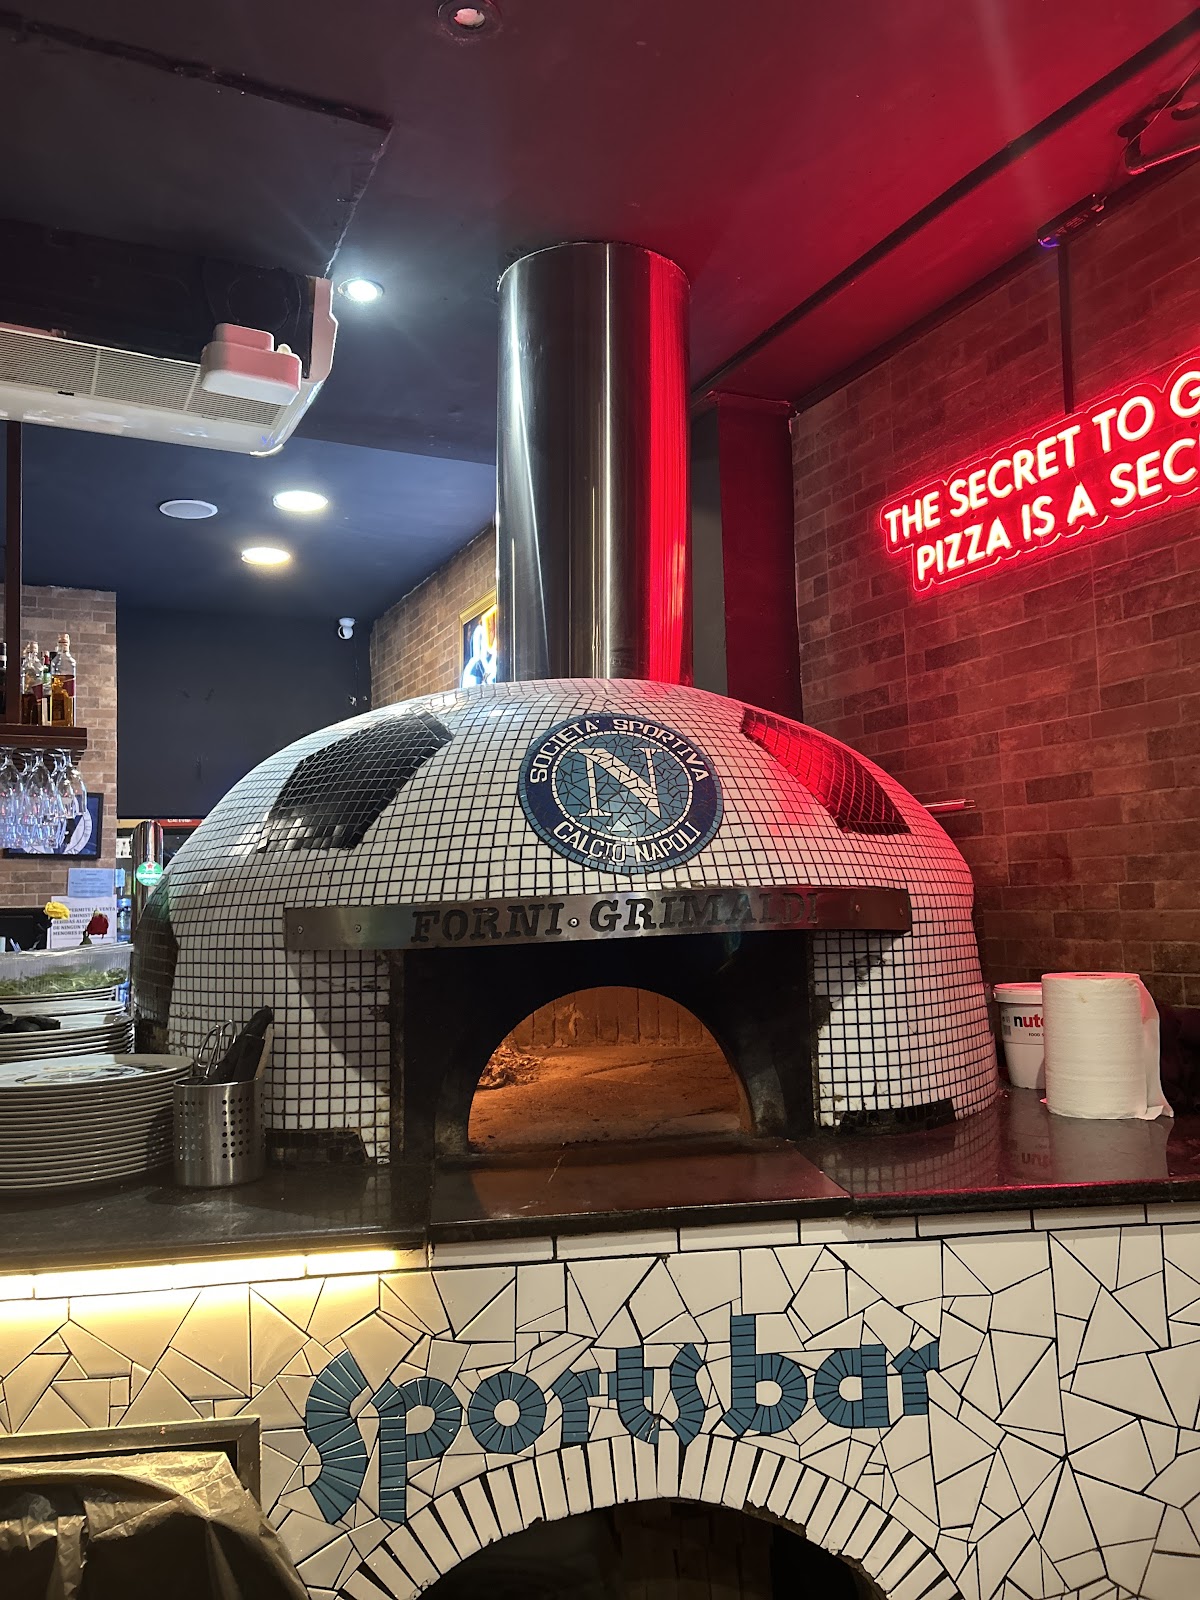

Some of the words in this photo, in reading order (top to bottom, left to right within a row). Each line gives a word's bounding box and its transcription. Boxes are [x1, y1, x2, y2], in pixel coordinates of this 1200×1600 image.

[884, 490, 941, 544] THE
[949, 424, 1081, 518] SECRET
[1092, 396, 1156, 454] TO
[916, 516, 1013, 581] PIZZA
[1021, 496, 1056, 541] IS
[1066, 481, 1098, 527] A
[1110, 436, 1200, 508] SEC
[569, 747, 664, 819] N
[612, 718, 710, 782] SPORTIVA
[553, 821, 626, 863] CALCIO
[634, 821, 702, 863] NAPOLI
[410, 902, 565, 943] FORNI
[589, 893, 819, 933] GRIMALDI
